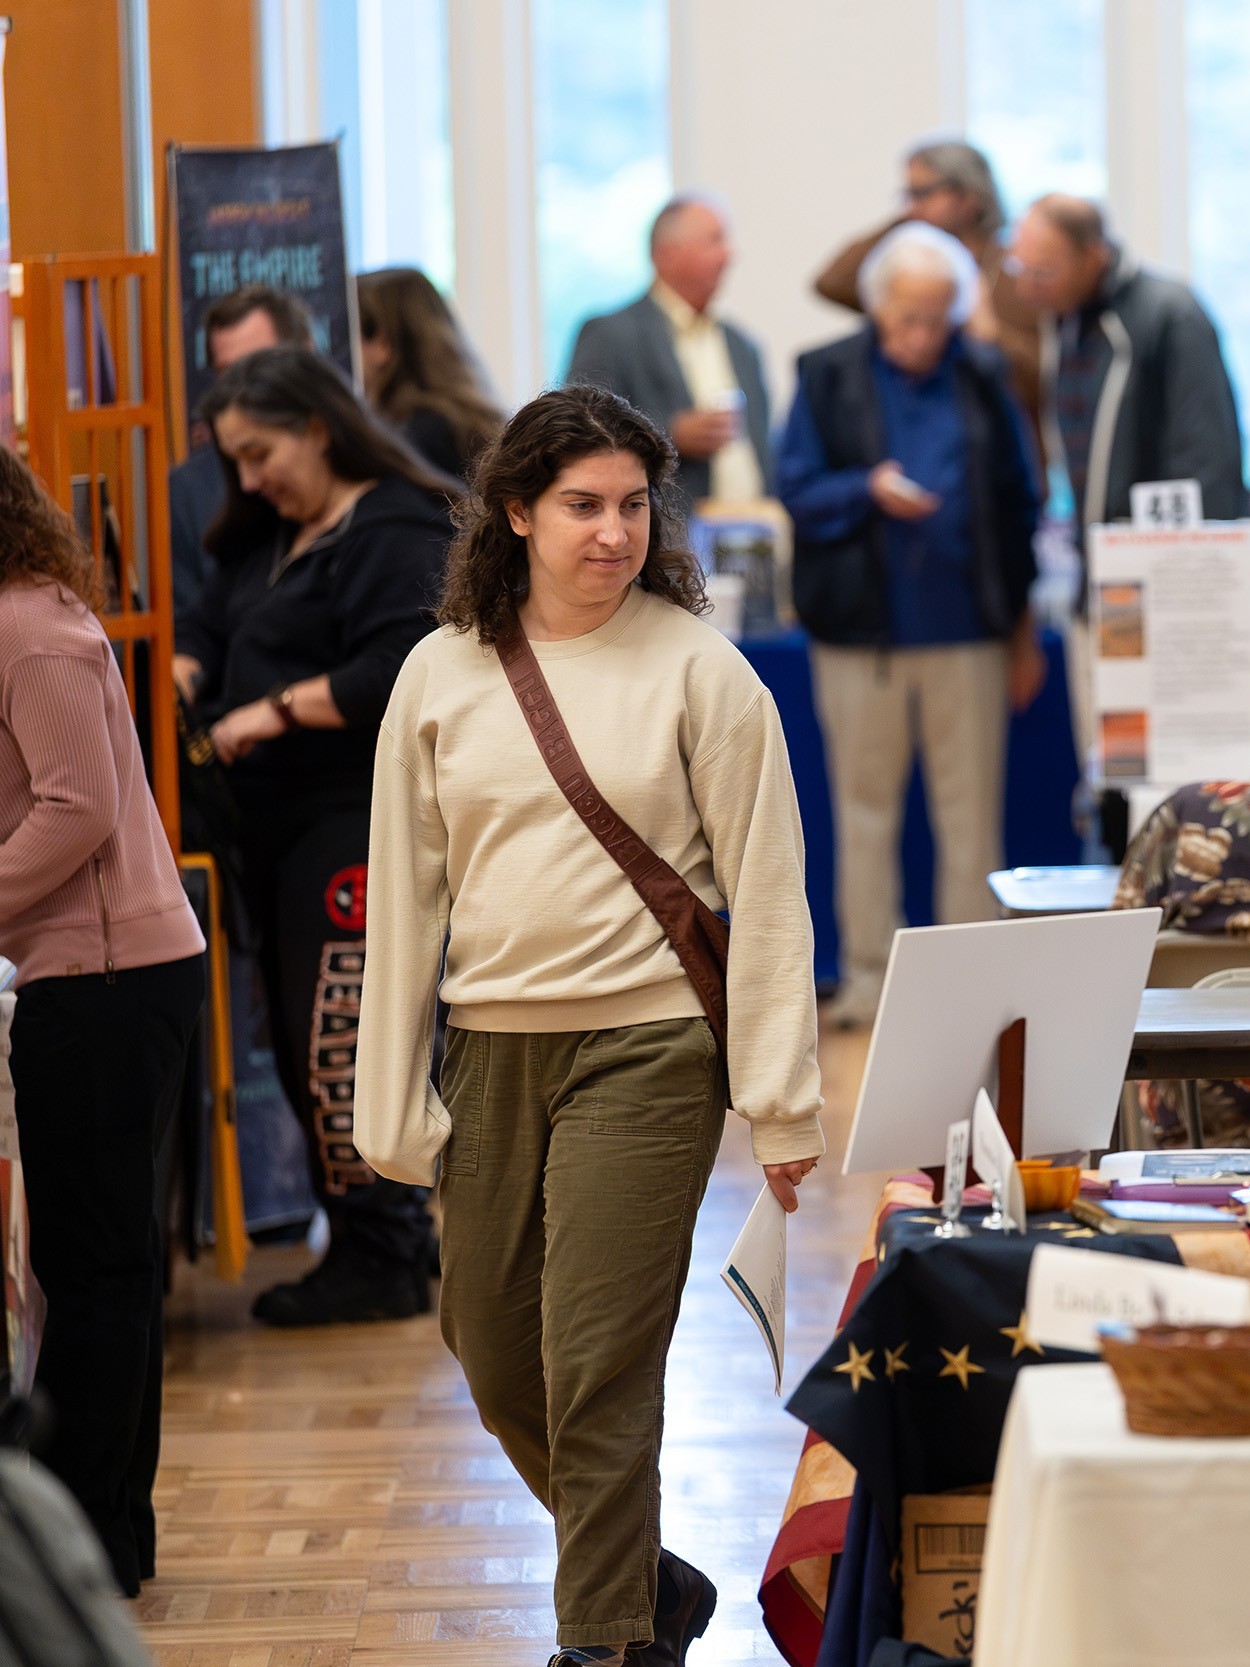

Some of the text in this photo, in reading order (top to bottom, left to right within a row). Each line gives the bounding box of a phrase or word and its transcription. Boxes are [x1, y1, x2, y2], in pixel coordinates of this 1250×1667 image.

[190, 243, 323, 298] THE EMPIRE
[514, 672, 644, 863] BAGGU BAGGU
